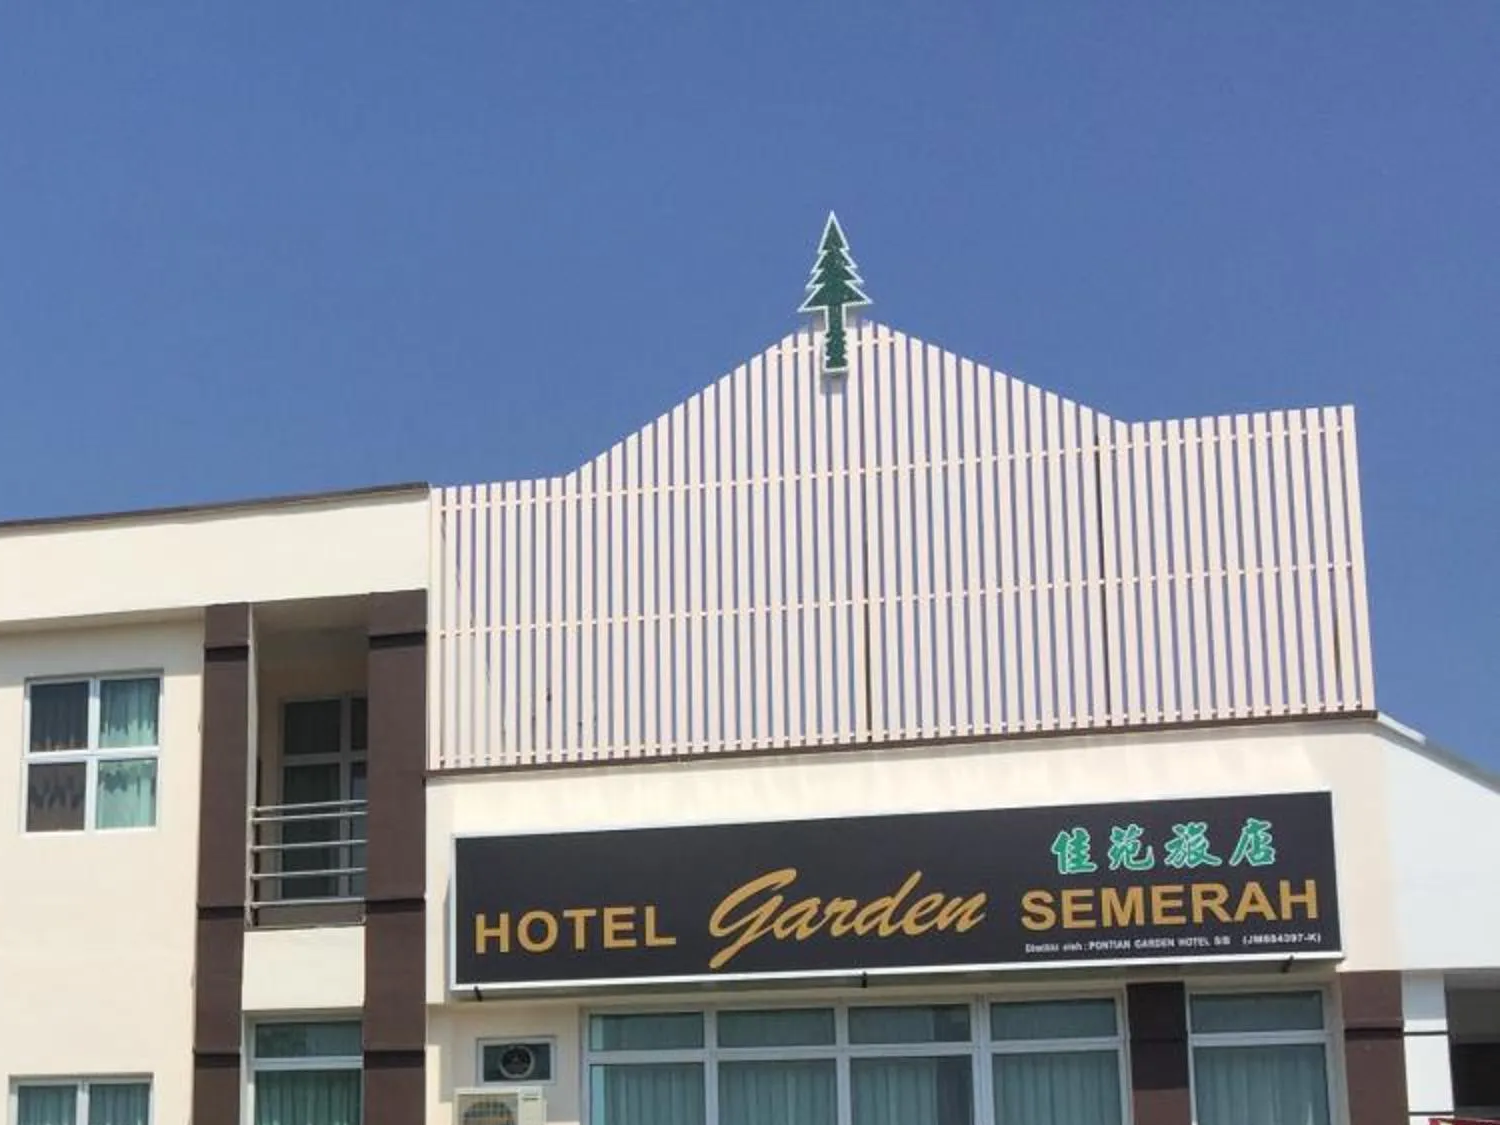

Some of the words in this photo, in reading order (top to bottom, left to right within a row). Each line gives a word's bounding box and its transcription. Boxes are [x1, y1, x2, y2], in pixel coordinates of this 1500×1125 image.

[1051, 817, 1277, 875] 佳苑旅店
[475, 904, 677, 955] HOTEL
[708, 867, 988, 970] Garden
[1020, 879, 1320, 932] SEMERAH
[1088, 938, 1131, 951] PONTIAN
[1134, 937, 1175, 950] GARDEN
[1178, 936, 1211, 948] HOTEL
